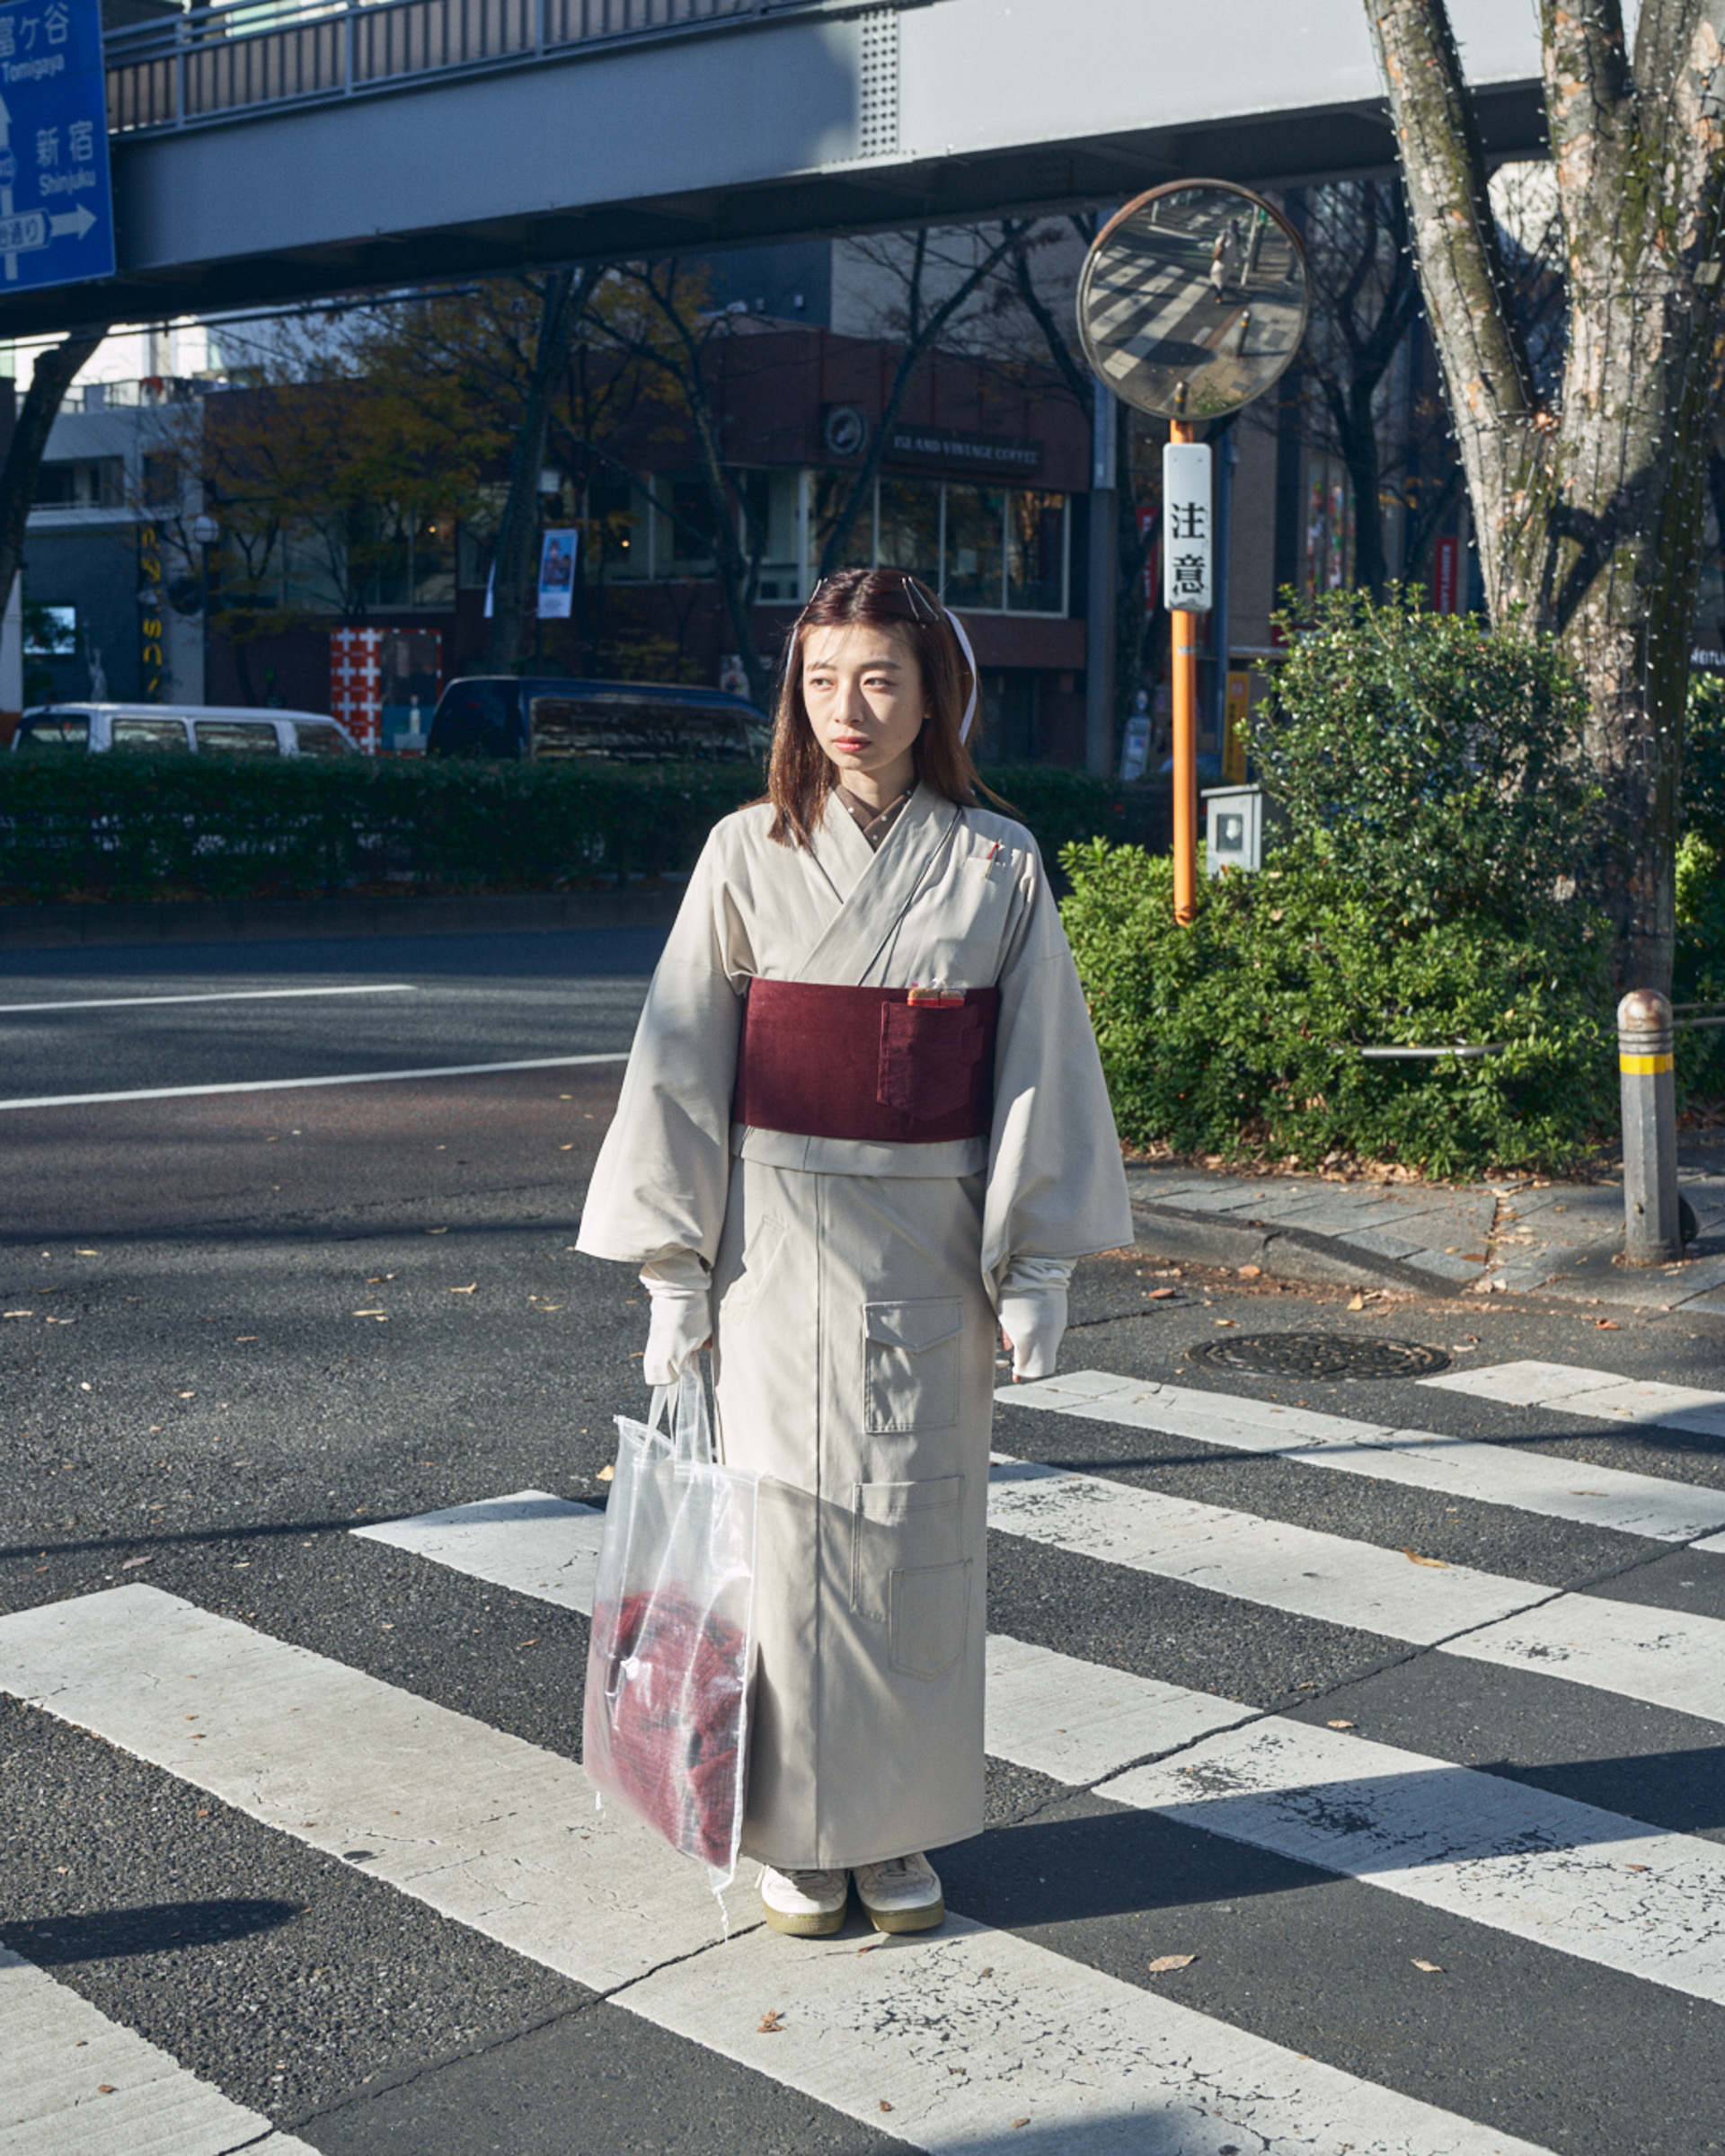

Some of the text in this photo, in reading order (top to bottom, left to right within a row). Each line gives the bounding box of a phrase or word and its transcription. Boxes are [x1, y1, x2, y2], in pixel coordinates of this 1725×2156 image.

[2, 54, 65, 83] Tomigaya
[36, 120, 93, 167] 新宿
[40, 166, 96, 196] Shinjuku
[995, 447, 1037, 464] COFFEE
[1171, 502, 1206, 596] 注意
